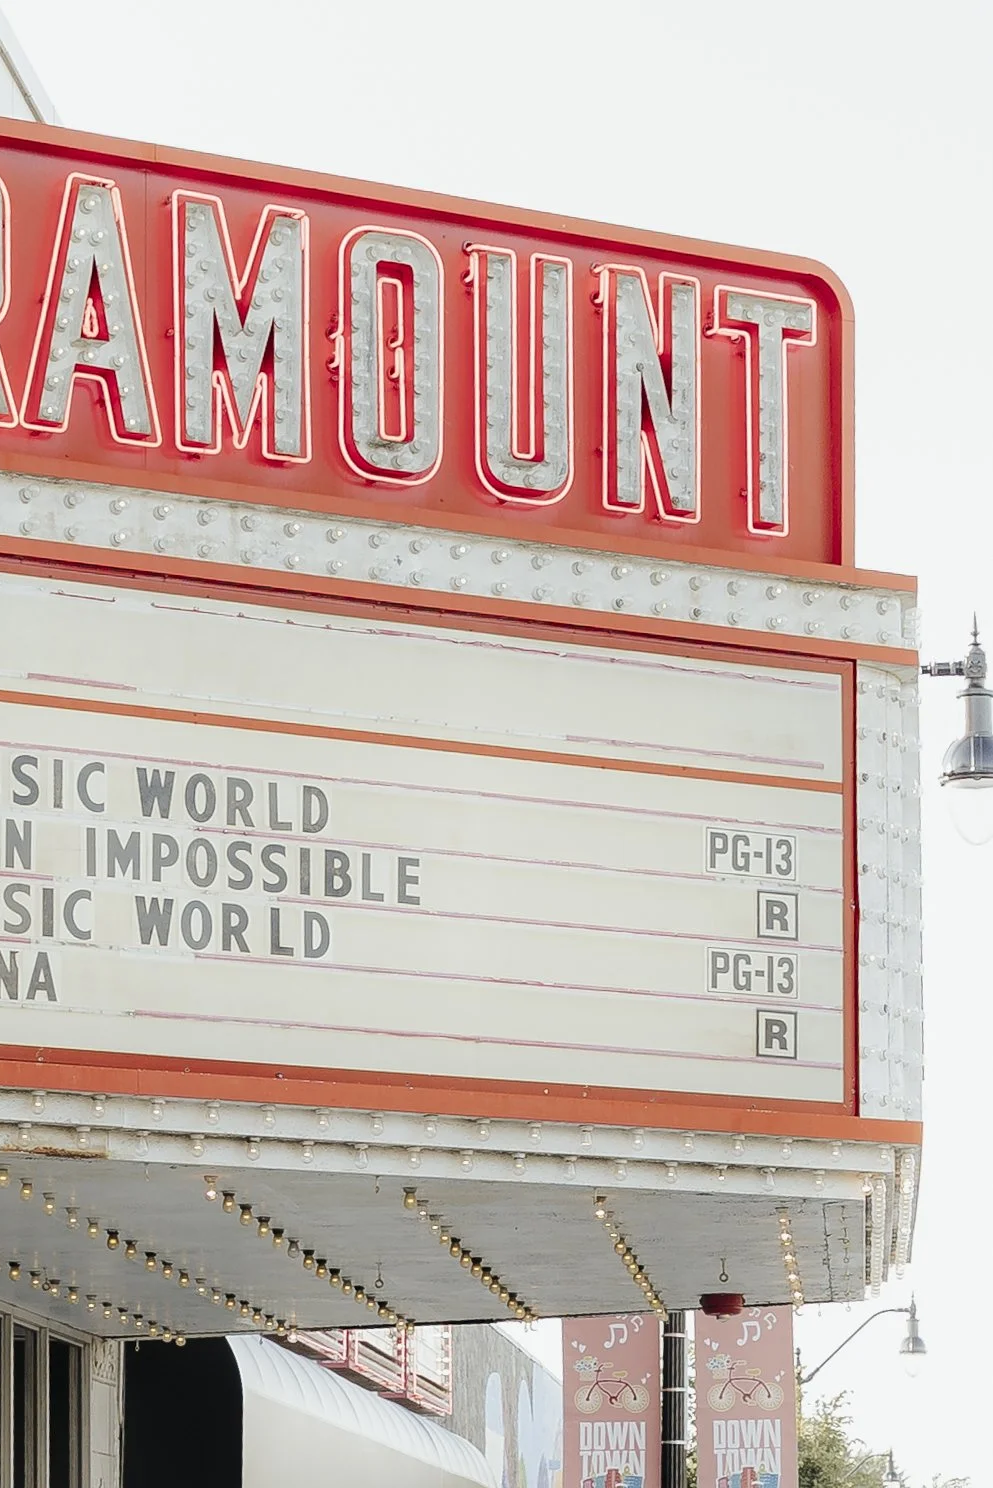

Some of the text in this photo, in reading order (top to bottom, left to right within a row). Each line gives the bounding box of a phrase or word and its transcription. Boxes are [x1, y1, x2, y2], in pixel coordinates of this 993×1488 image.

[136, 767, 329, 834] WORLD
[709, 831, 792, 876] PG-13
[86, 827, 421, 906] IMPOSSIBLE
[765, 899, 789, 932] R
[135, 895, 330, 959] WORLD
[711, 951, 794, 994] PG-13
[764, 1018, 788, 1050] R
[579, 1421, 646, 1450] DOWN
[713, 1419, 781, 1448] DOWN
[579, 1450, 646, 1479] TOWN
[714, 1448, 781, 1477] TOWN
